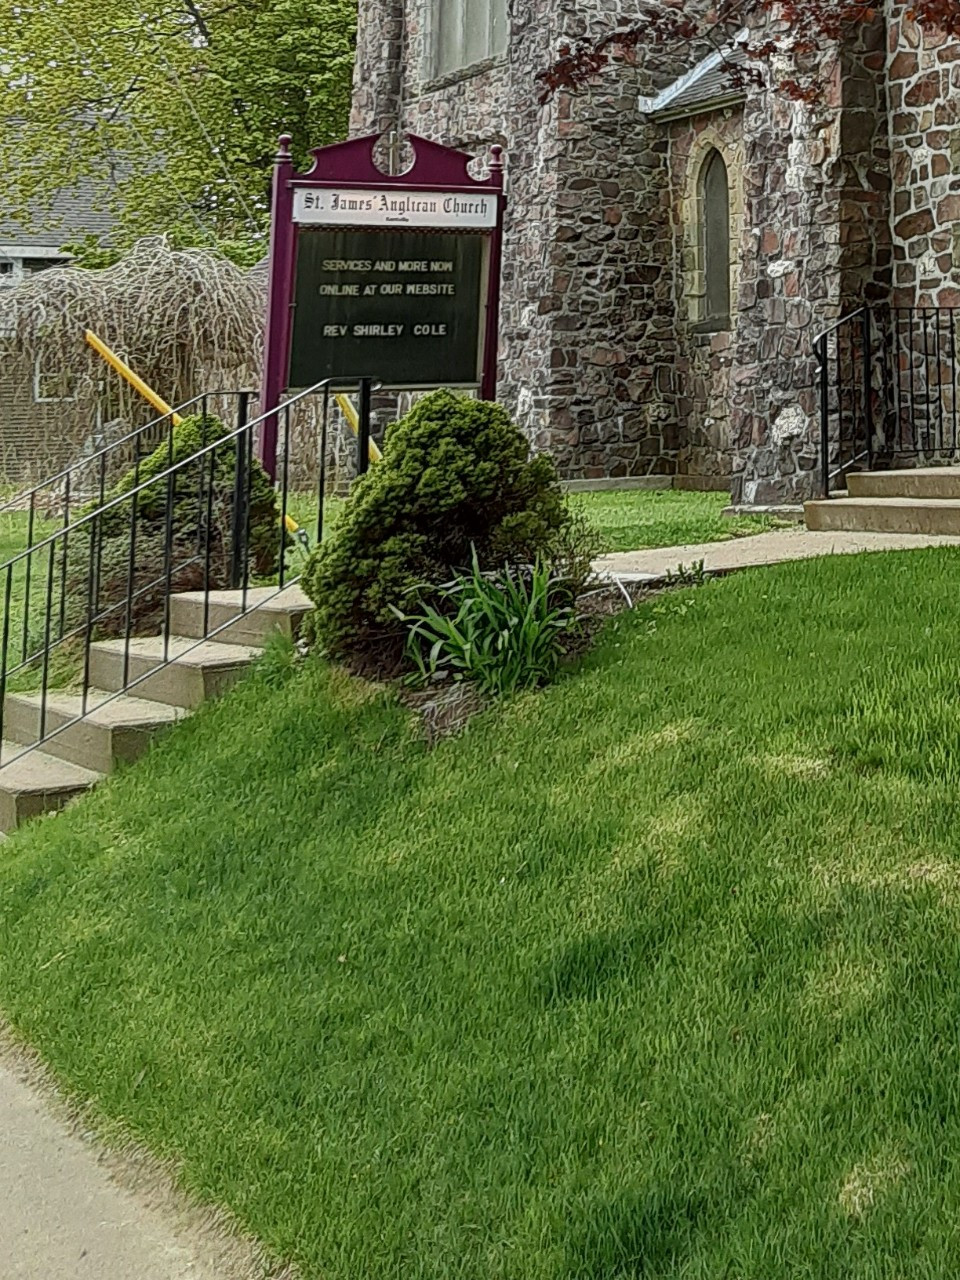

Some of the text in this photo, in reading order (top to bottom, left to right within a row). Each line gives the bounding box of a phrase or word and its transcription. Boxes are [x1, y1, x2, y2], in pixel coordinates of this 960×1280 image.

[304, 192, 324, 210] St.
[378, 195, 437, 216] Anglican
[443, 197, 487, 218] Church
[322, 260, 453, 272] SERVICES AND MORE NOW
[320, 284, 455, 296] ONLINE AT OUR WEBSITE
[323, 324, 447, 337] REV SHIRLEY COLE
